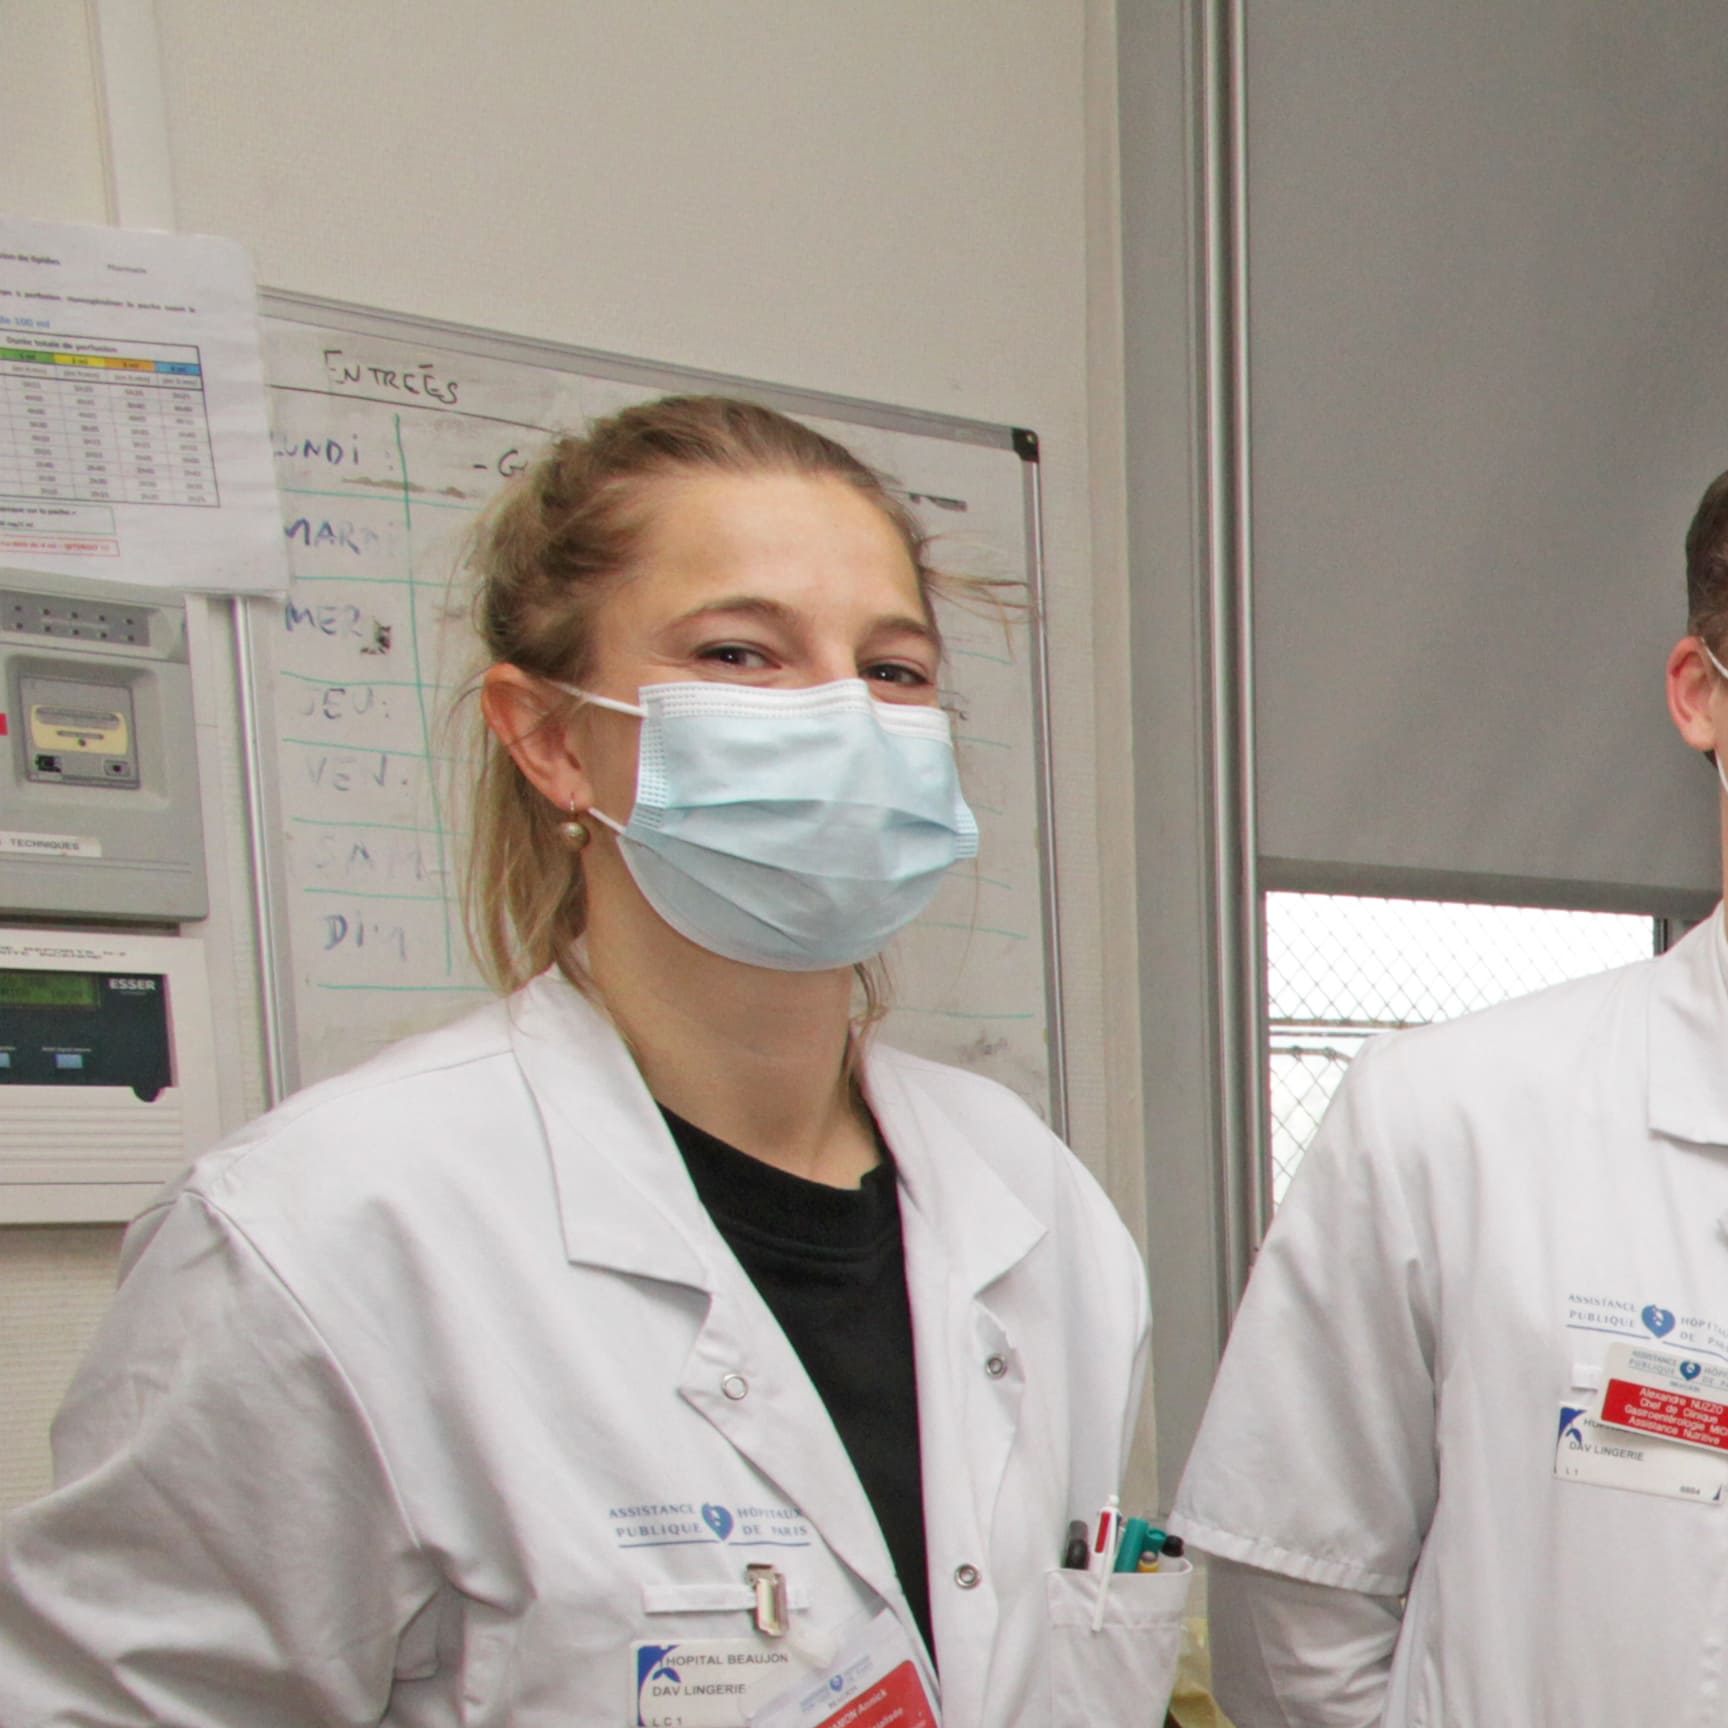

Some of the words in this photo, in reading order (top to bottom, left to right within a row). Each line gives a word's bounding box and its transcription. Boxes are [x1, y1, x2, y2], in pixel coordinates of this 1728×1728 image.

[11, 838, 80, 850] TECHNIQUES
[110, 978, 156, 990] ESSER
[1568, 1294, 1636, 1312] ASSISTANCE
[1569, 1310, 1635, 1328] PUBLIQUE
[1680, 1331, 1694, 1341] DE
[1640, 1398, 1662, 1410] Chef
[1666, 1405, 1678, 1414] de
[1683, 1408, 1718, 1424] Clinique
[1569, 1441, 1591, 1453] DAV
[1594, 1445, 1644, 1460] LINGERIE
[609, 1504, 696, 1519] ASSISTANCE
[616, 1522, 702, 1538] PUBLIQUE
[742, 1526, 762, 1536] DE
[771, 1525, 808, 1536] PARIS
[666, 1654, 723, 1666] HOPITAL
[727, 1653, 789, 1664] BEAUJON
[652, 1686, 681, 1697] DAV
[684, 1684, 745, 1695] LINGERIE
[652, 1718, 660, 1727] L
[665, 1717, 673, 1727] C
